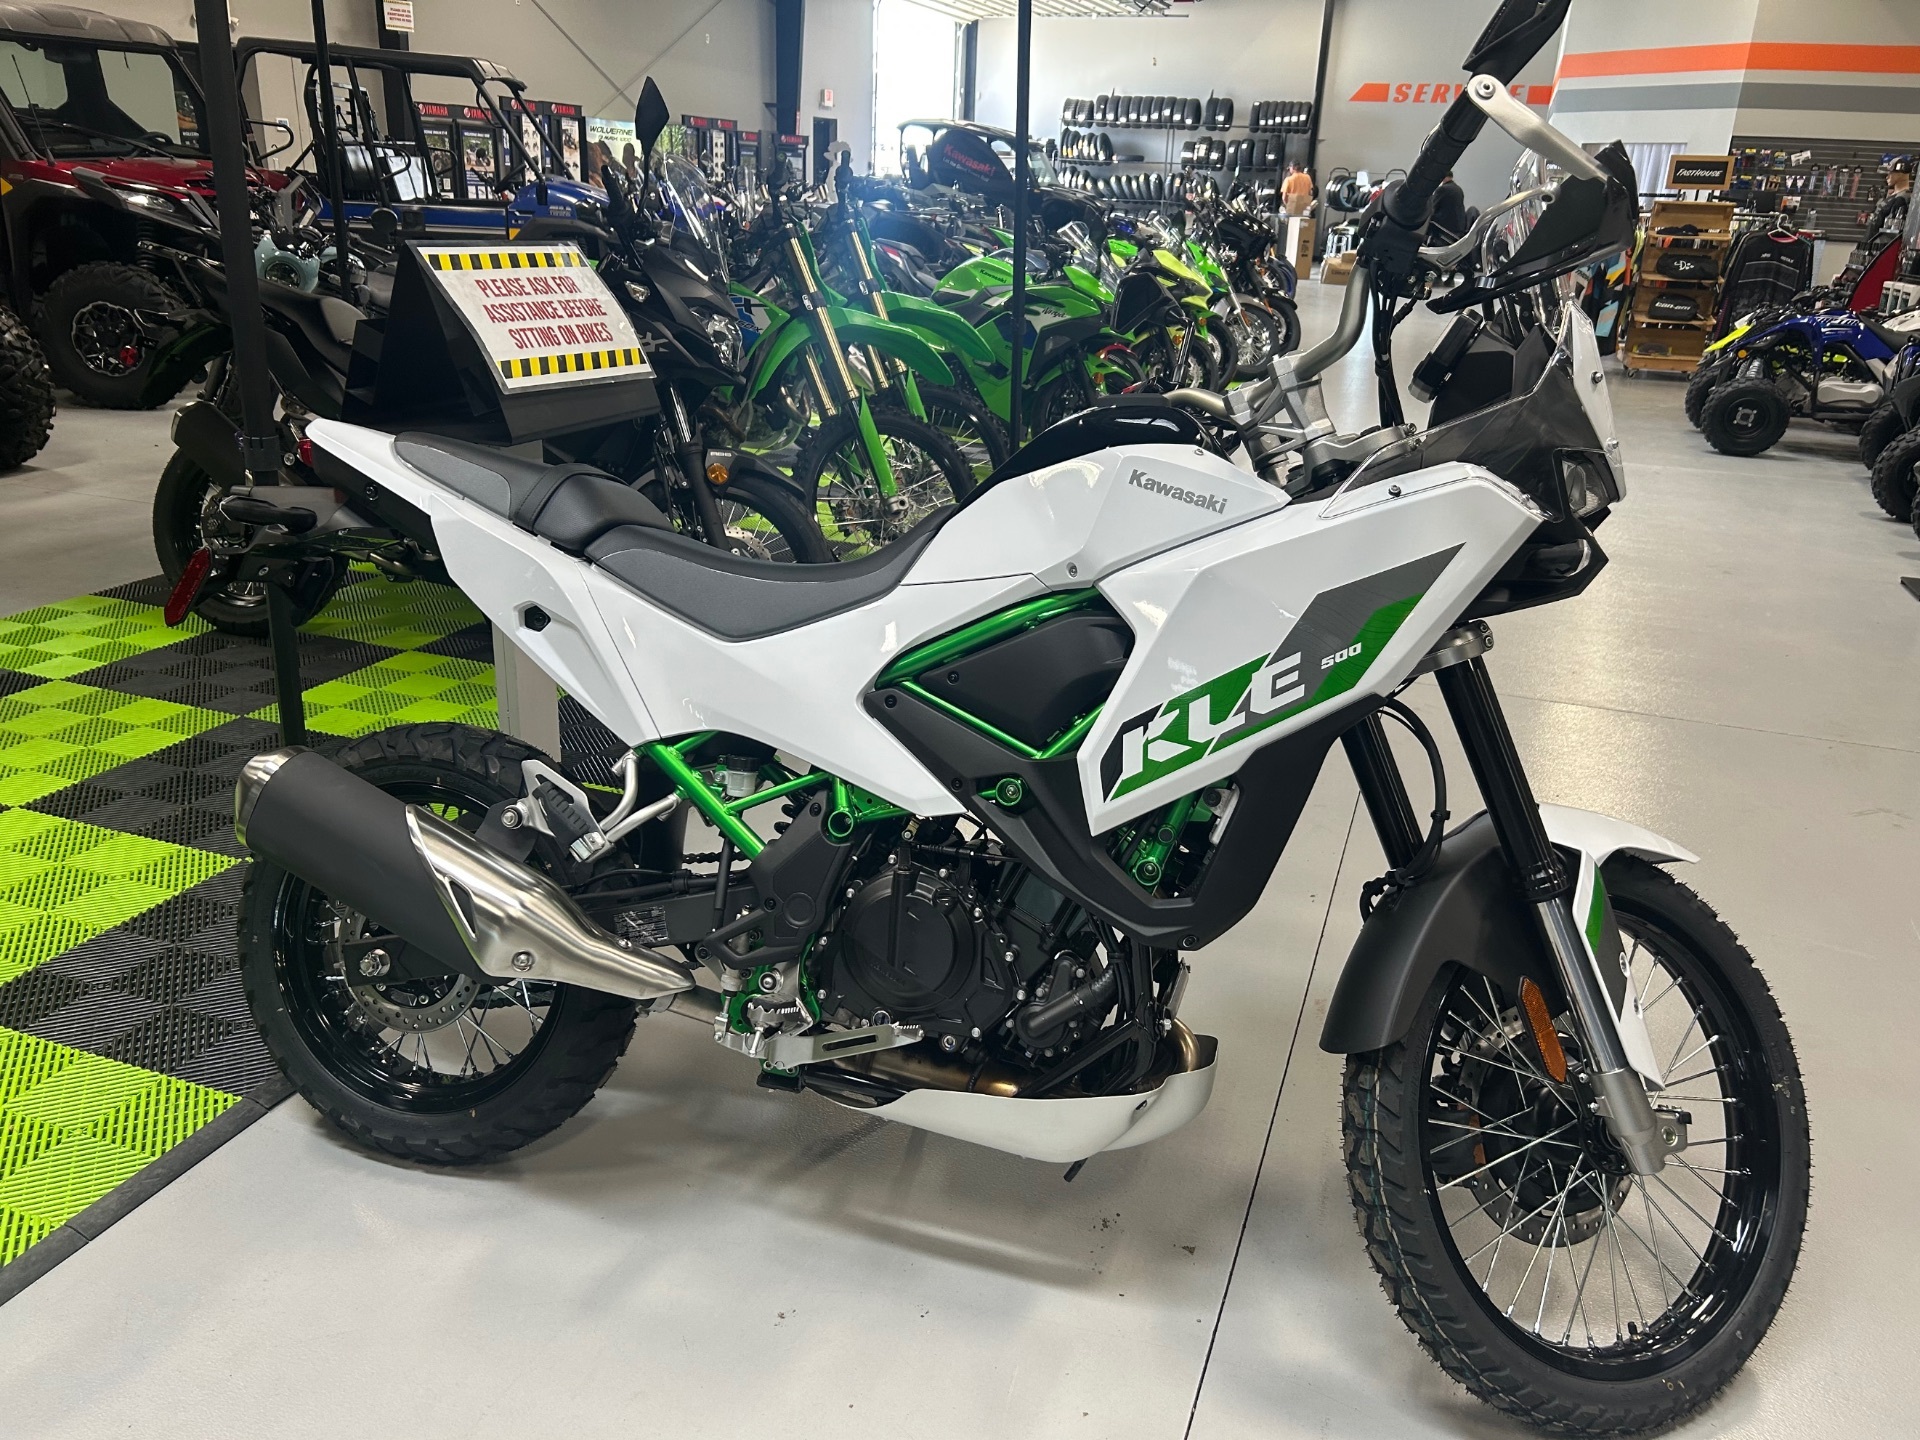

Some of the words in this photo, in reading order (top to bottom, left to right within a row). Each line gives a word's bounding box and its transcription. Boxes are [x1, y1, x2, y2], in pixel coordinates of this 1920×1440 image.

[1393, 83, 1525, 104] SERVE
[424, 104, 448, 117] YAMAHA
[589, 125, 634, 136] WOLVERINE
[944, 143, 996, 177] Kawasaki
[474, 276, 531, 298] PLEASE
[525, 276, 553, 295] ASK
[552, 275, 582, 294] FOR
[980, 268, 1007, 284] Kawasaki
[482, 300, 564, 324] ASSISTANCE
[559, 298, 607, 319] BEFORE
[1041, 306, 1067, 318] Ninja
[508, 328, 561, 350] SITTING
[557, 325, 580, 345] ON
[575, 322, 614, 344] BIKES
[1128, 468, 1228, 515] Kawasaki
[1320, 642, 1362, 670] 500
[1122, 651, 1305, 780] KLE
